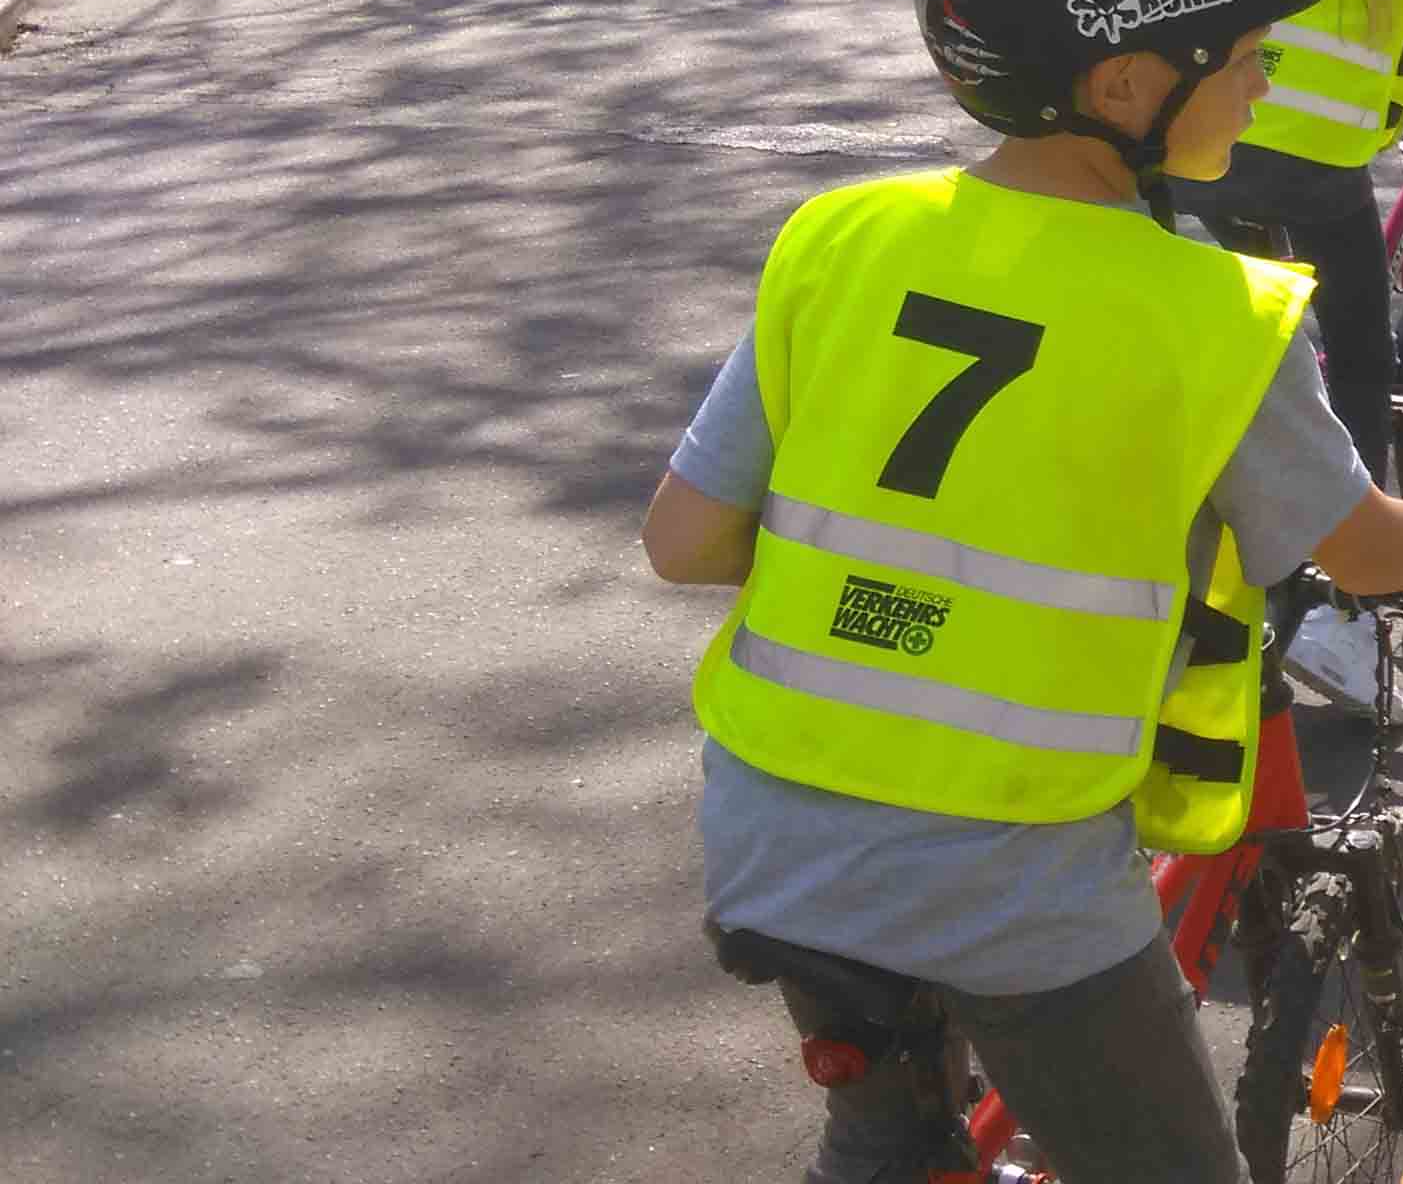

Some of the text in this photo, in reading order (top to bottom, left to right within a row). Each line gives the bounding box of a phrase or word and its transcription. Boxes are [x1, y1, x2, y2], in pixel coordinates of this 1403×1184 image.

[875, 289, 1047, 501] 7
[839, 584, 950, 627] VERKEHRS
[895, 585, 953, 608] DEUTSCHE
[830, 607, 911, 641] WACHT
